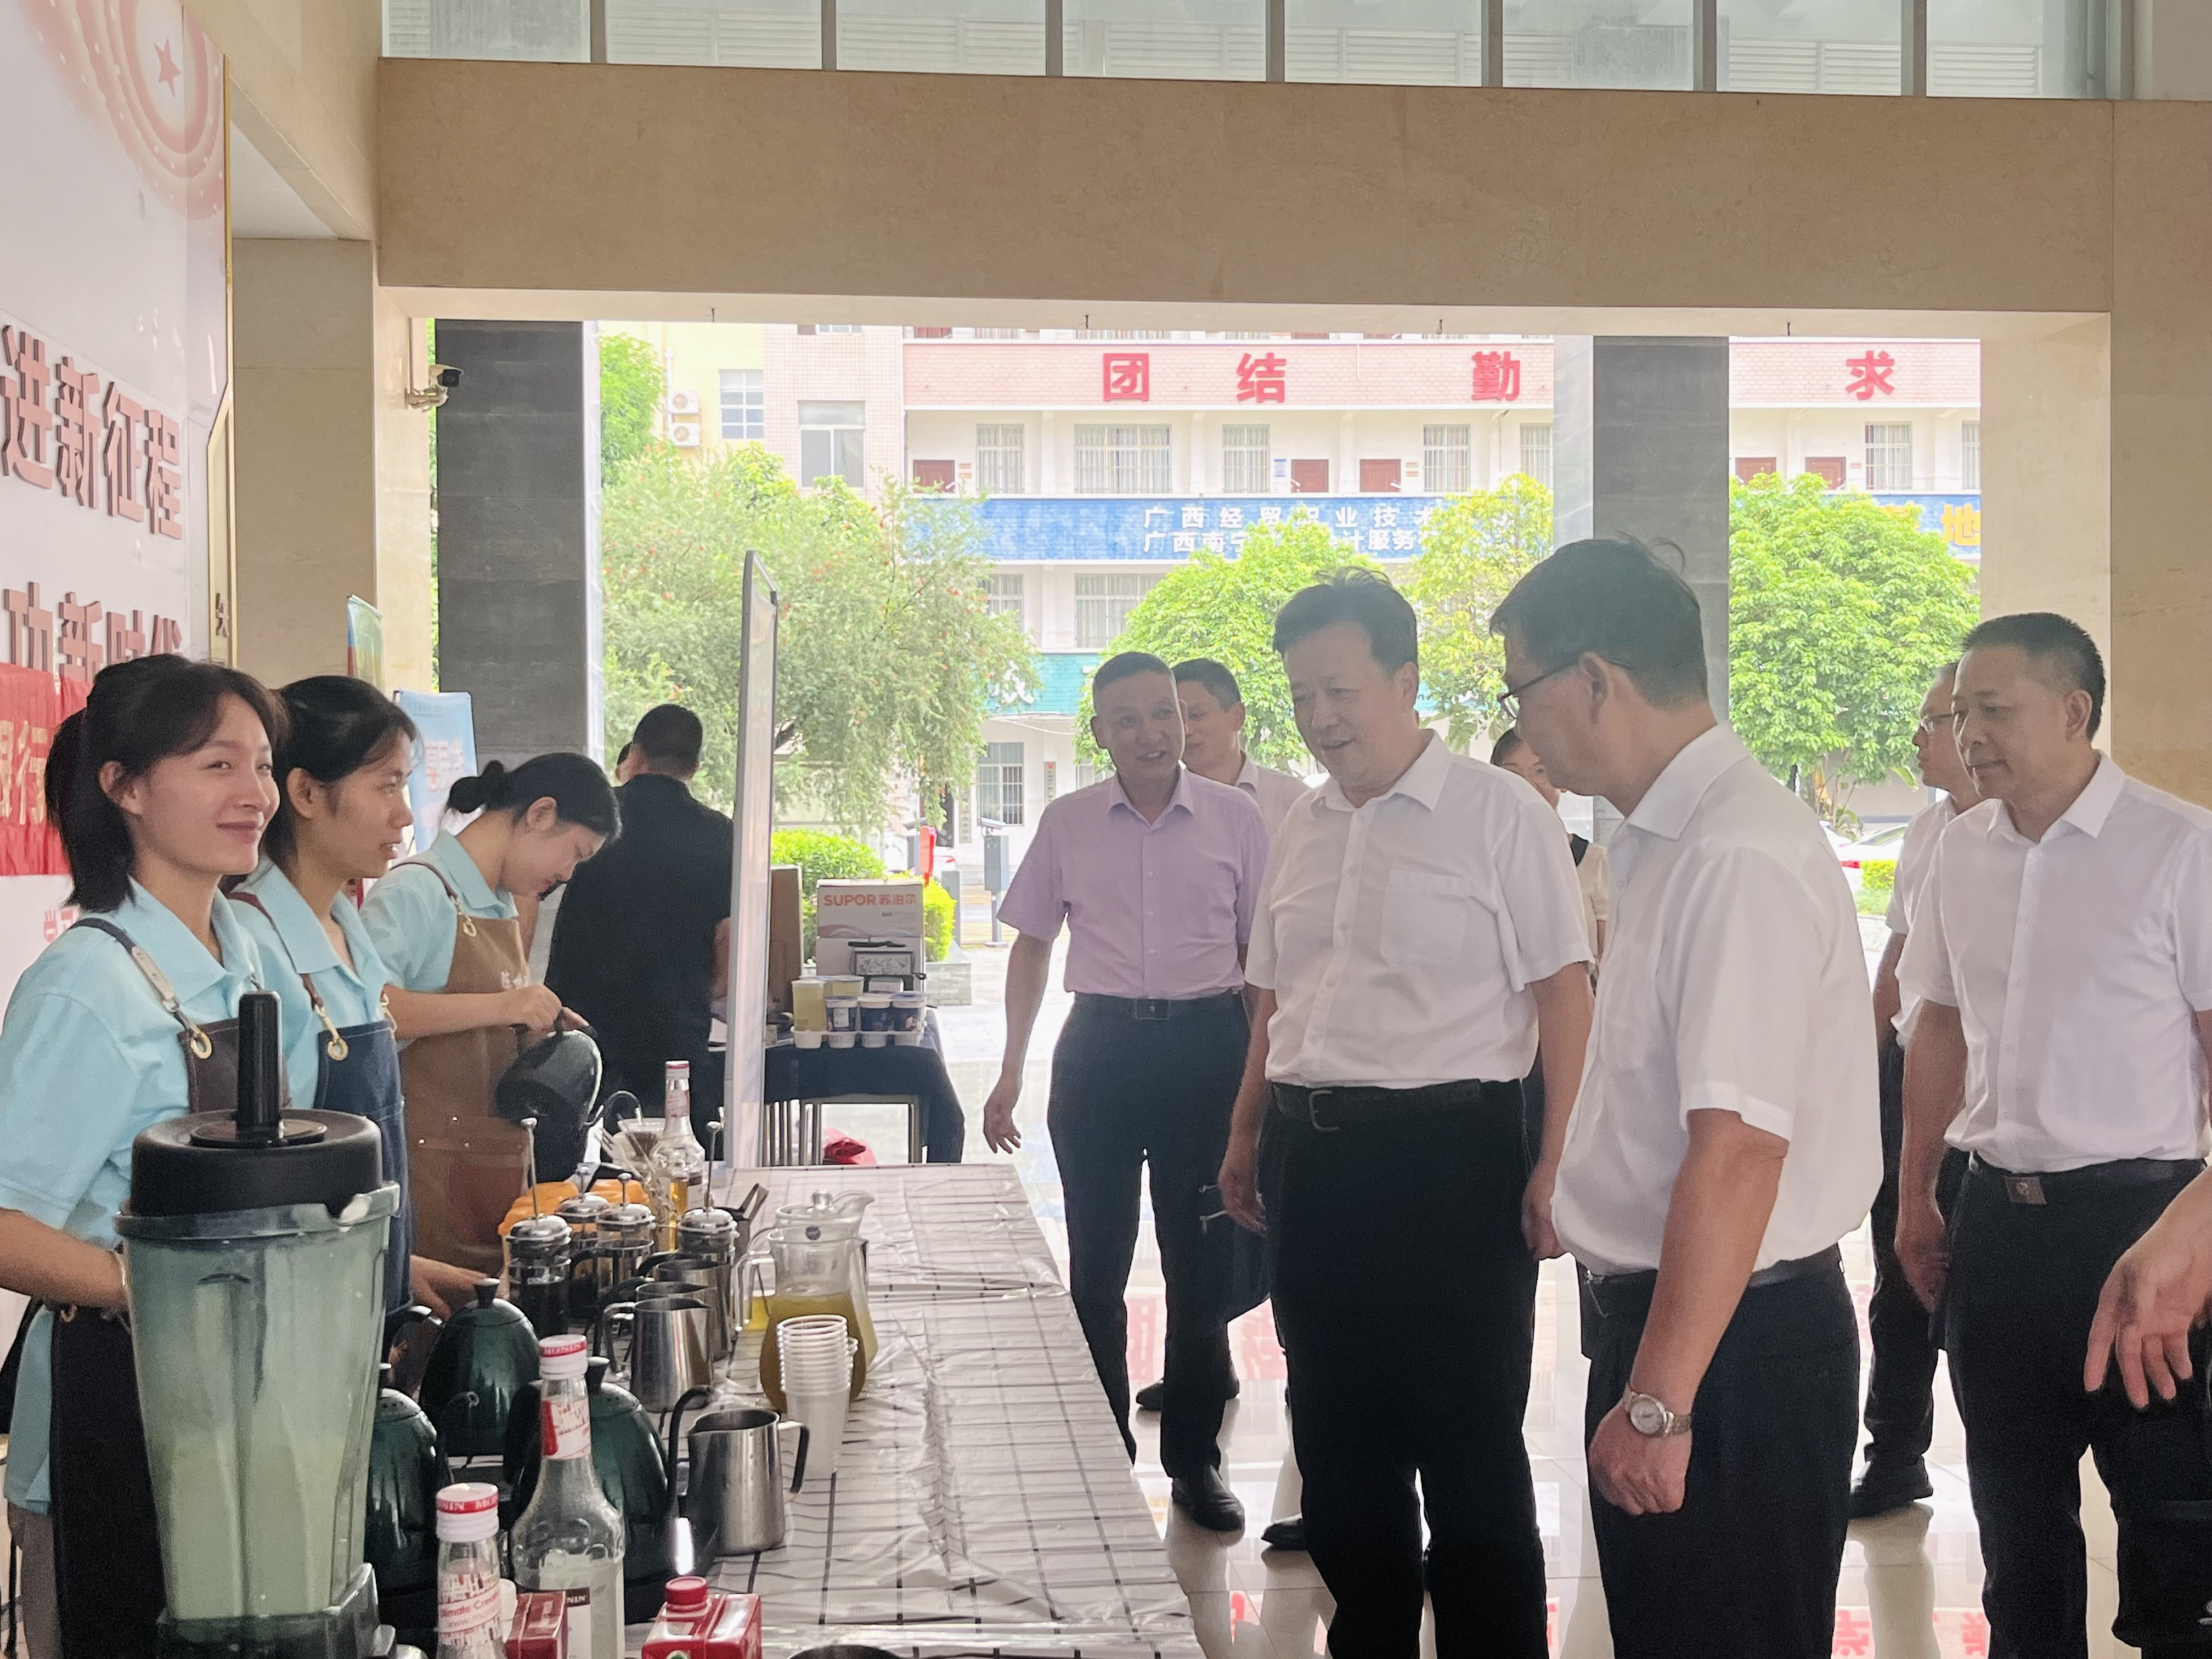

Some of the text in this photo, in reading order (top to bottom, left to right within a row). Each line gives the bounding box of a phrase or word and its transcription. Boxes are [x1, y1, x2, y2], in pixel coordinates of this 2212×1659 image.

[1845, 350, 1895, 400] 求
[0, 324, 183, 540] 进新征程
[824, 893, 916, 906] SUPOR 苏泊尔
[437, 1499, 465, 1511] NIN
